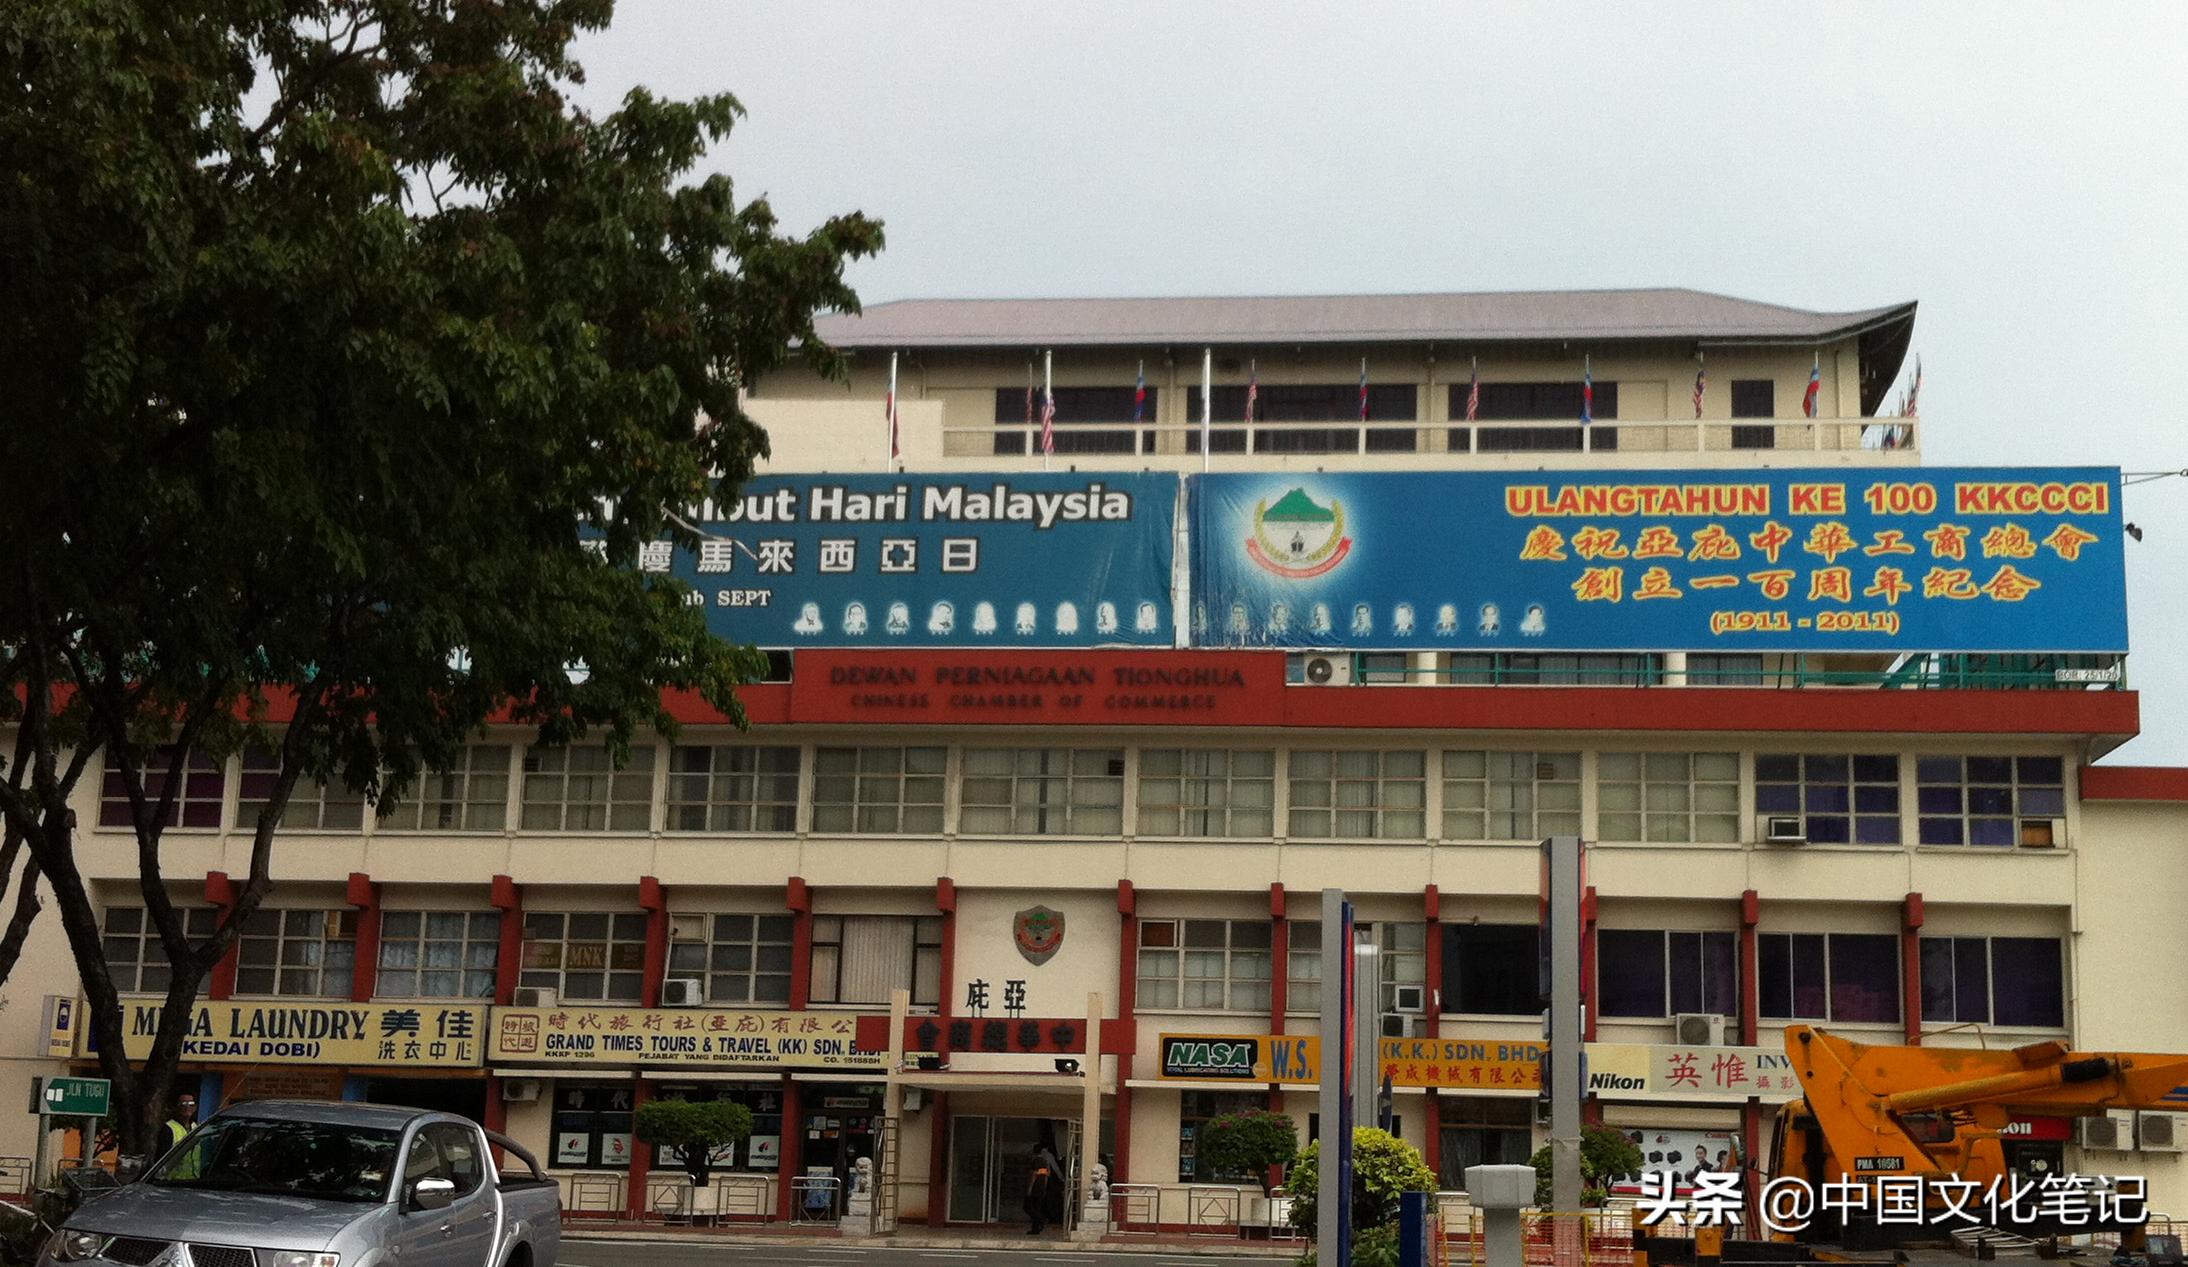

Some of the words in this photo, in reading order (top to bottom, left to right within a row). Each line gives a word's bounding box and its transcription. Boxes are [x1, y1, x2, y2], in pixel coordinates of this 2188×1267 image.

[810, 486, 908, 521] Hari
[923, 484, 1130, 529] Malaysia
[1506, 485, 1770, 516] ULANGTAHUN
[1789, 484, 1846, 515] KE
[1865, 483, 1938, 514] 100
[1955, 482, 2109, 514] KKCCCI
[717, 589, 771, 607] SEPT
[1710, 611, 1792, 635] (1911
[1816, 611, 1900, 635] 2011)
[830, 666, 917, 686] DEWAN
[935, 666, 1096, 686] PERNIAGAAN
[1112, 667, 1246, 688] TIONGHUA
[950, 693, 1043, 710] CHAMBER
[1058, 694, 1084, 710] OF
[230, 1008, 370, 1040] LAUNDRY
[380, 1008, 475, 1039] 美佳
[259, 1042, 321, 1060] DOBI)
[376, 1041, 473, 1061] 洗衣中心
[546, 1033, 595, 1051] GRAND
[602, 1034, 643, 1052] TIMES
[651, 1035, 697, 1053] TOURS
[702, 1037, 713, 1052] &
[718, 1037, 772, 1054] TRAVEL
[777, 1038, 808, 1056] (KK)
[1167, 1042, 1250, 1068] NASA
[1383, 1042, 1438, 1061] (K.K.)
[1271, 1039, 1313, 1079] W.S.
[1589, 1073, 1646, 1090] Nikon
